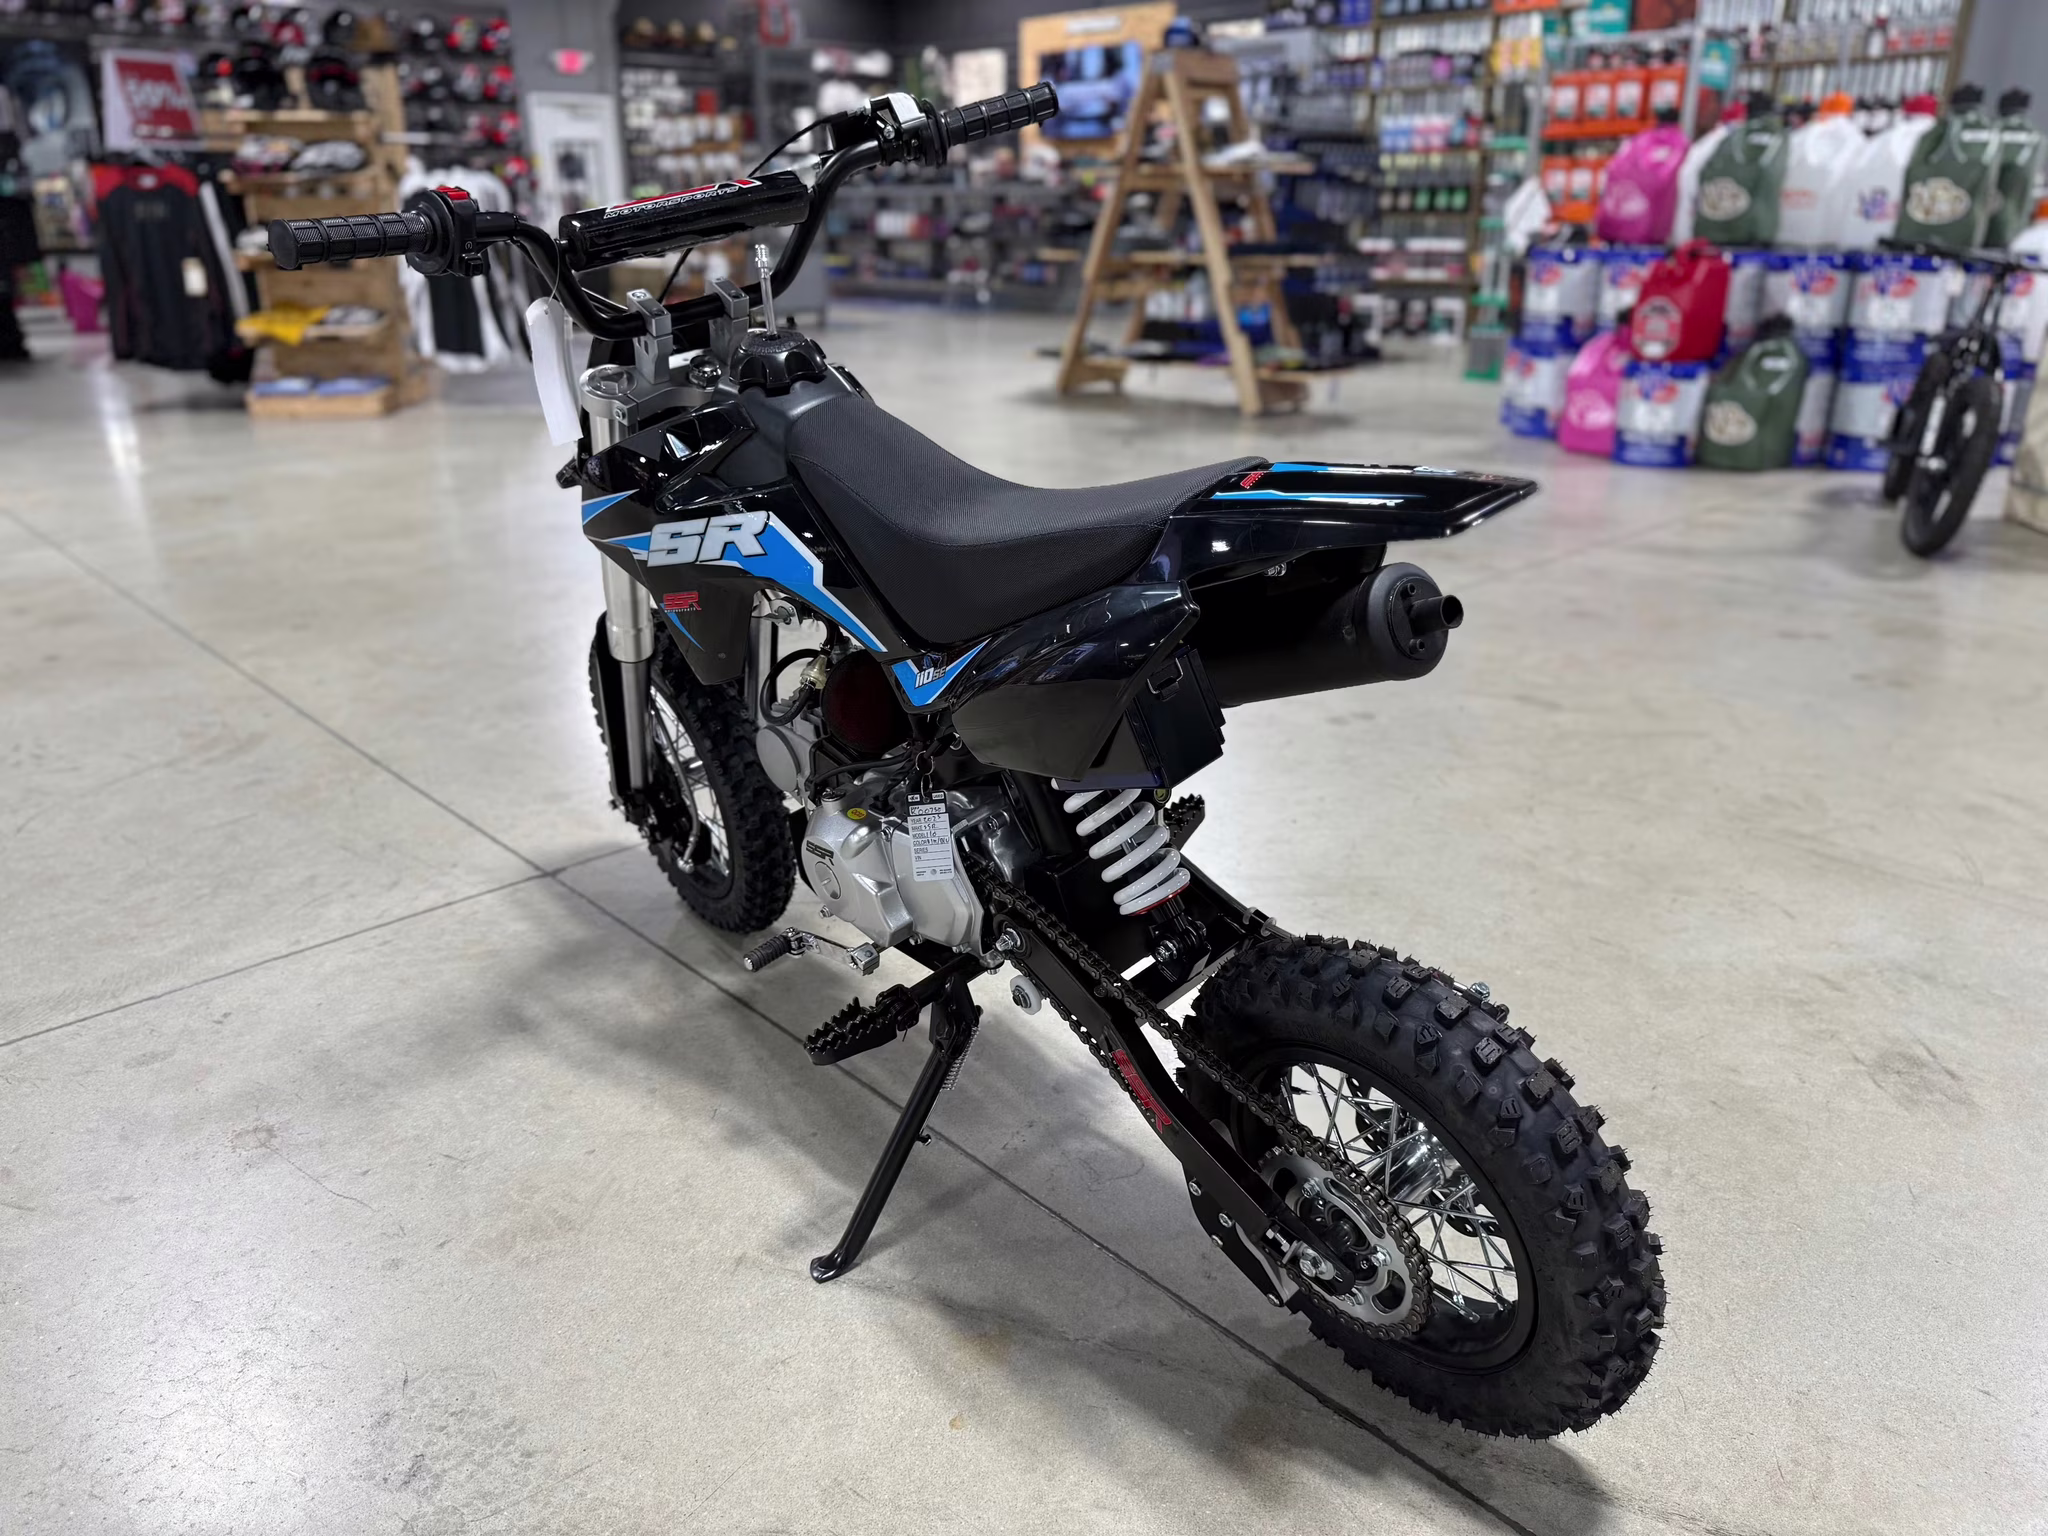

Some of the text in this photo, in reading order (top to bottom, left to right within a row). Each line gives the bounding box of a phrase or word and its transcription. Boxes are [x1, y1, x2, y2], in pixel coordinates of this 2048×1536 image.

[603, 186, 740, 219] MOTORSPORTS
[647, 510, 769, 567] SR
[663, 591, 702, 611] SSR
[806, 839, 835, 867] SSR
[1111, 1049, 1172, 1134] SSR
